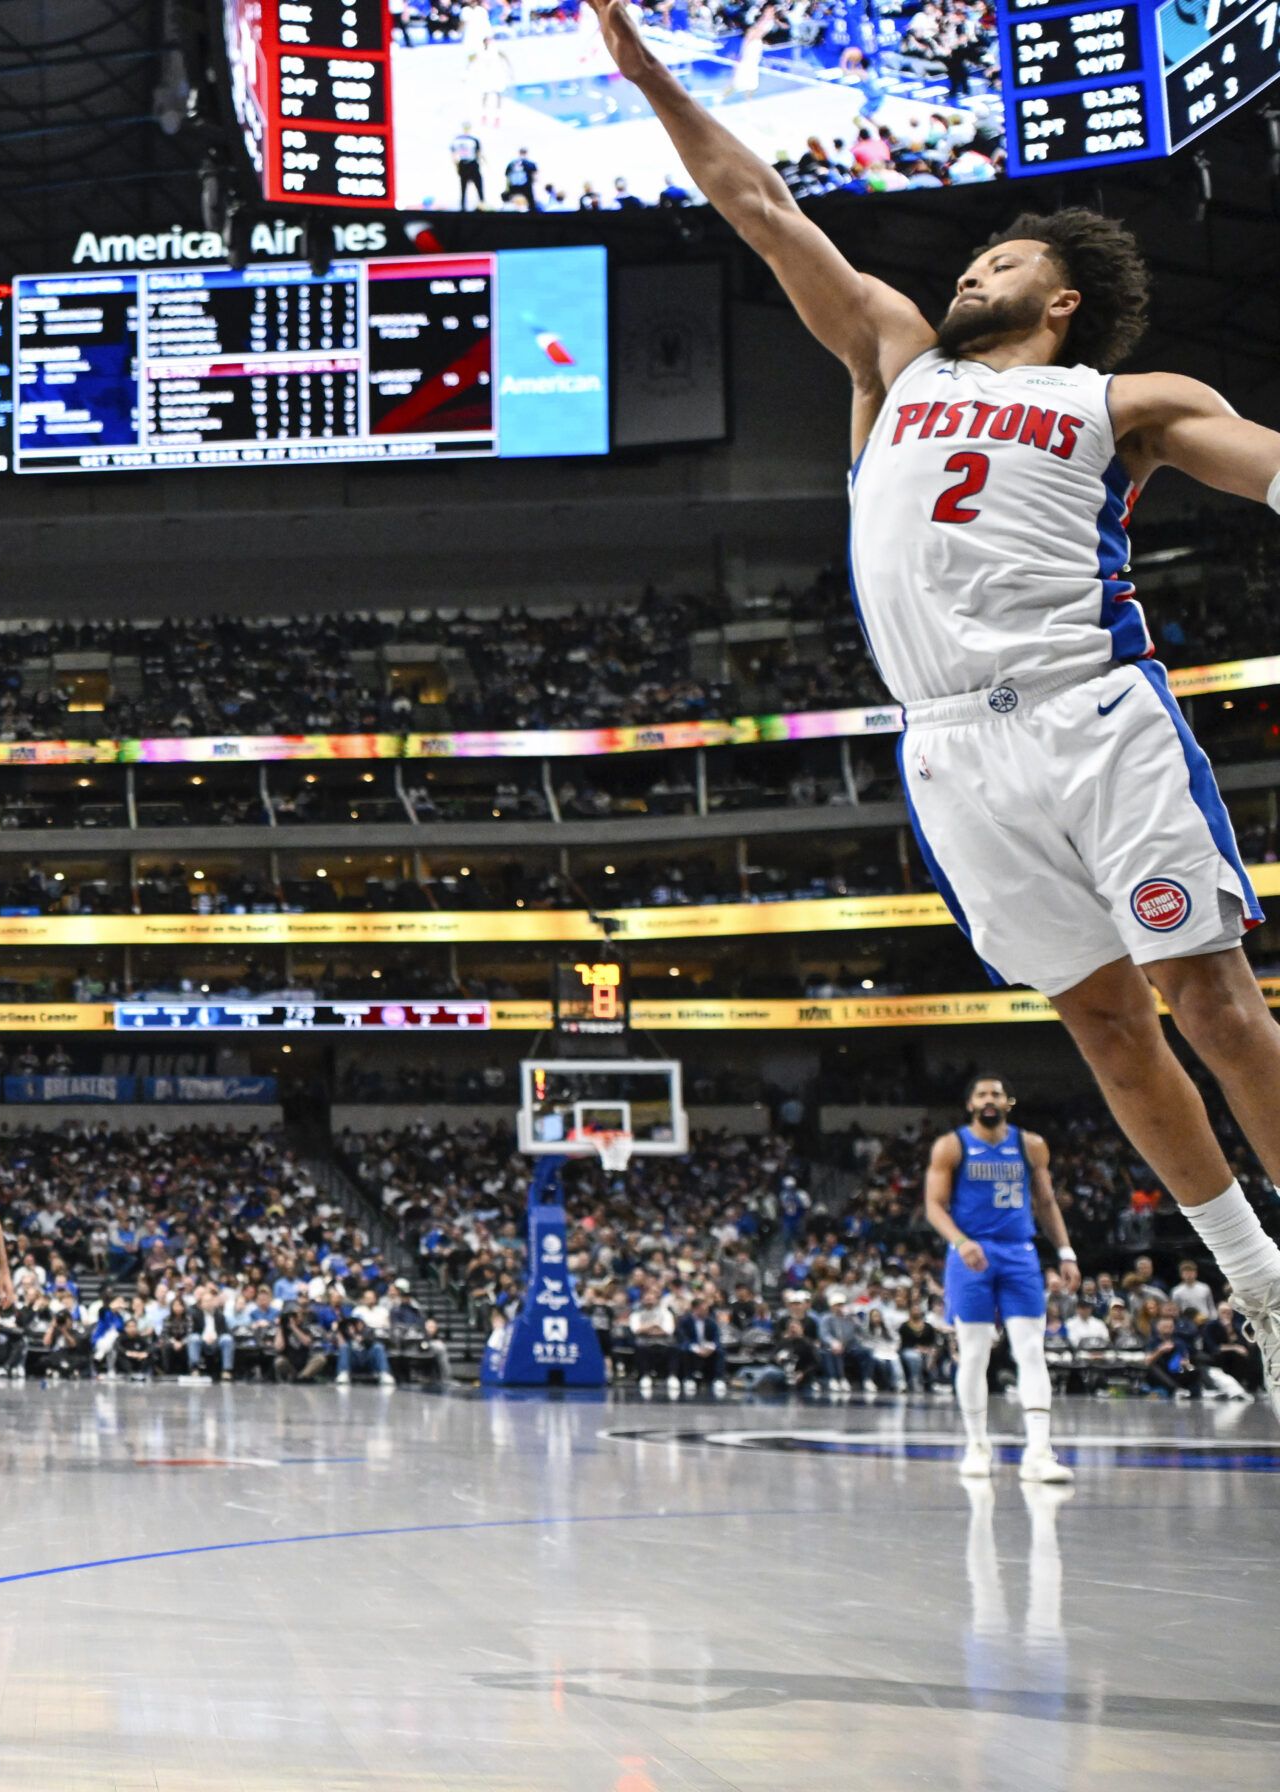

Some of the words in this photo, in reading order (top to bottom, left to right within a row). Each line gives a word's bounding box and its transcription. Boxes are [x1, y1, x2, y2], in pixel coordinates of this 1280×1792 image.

[1016, 22, 1043, 41] FG
[1018, 41, 1060, 62] 3-PT
[1074, 31, 1125, 54] 10/21
[1019, 65, 1044, 84] FT
[1224, 77, 1239, 100] 3
[1024, 118, 1066, 139] 3-PT
[1024, 142, 1050, 162] FT
[72, 224, 229, 264] America
[500, 375, 601, 395] American
[892, 400, 1085, 460] PISTONS
[266, 448, 287, 460] AT
[931, 451, 990, 524] 2
[1140, 891, 1174, 909] DETROIT
[1144, 900, 1180, 919] PISTONS
[593, 985, 616, 1018] 8
[856, 1002, 950, 1018] ALEXANDER
[954, 1000, 990, 1015] LAW
[39, 1012, 79, 1023] Center
[993, 1182, 1023, 1208] 26
